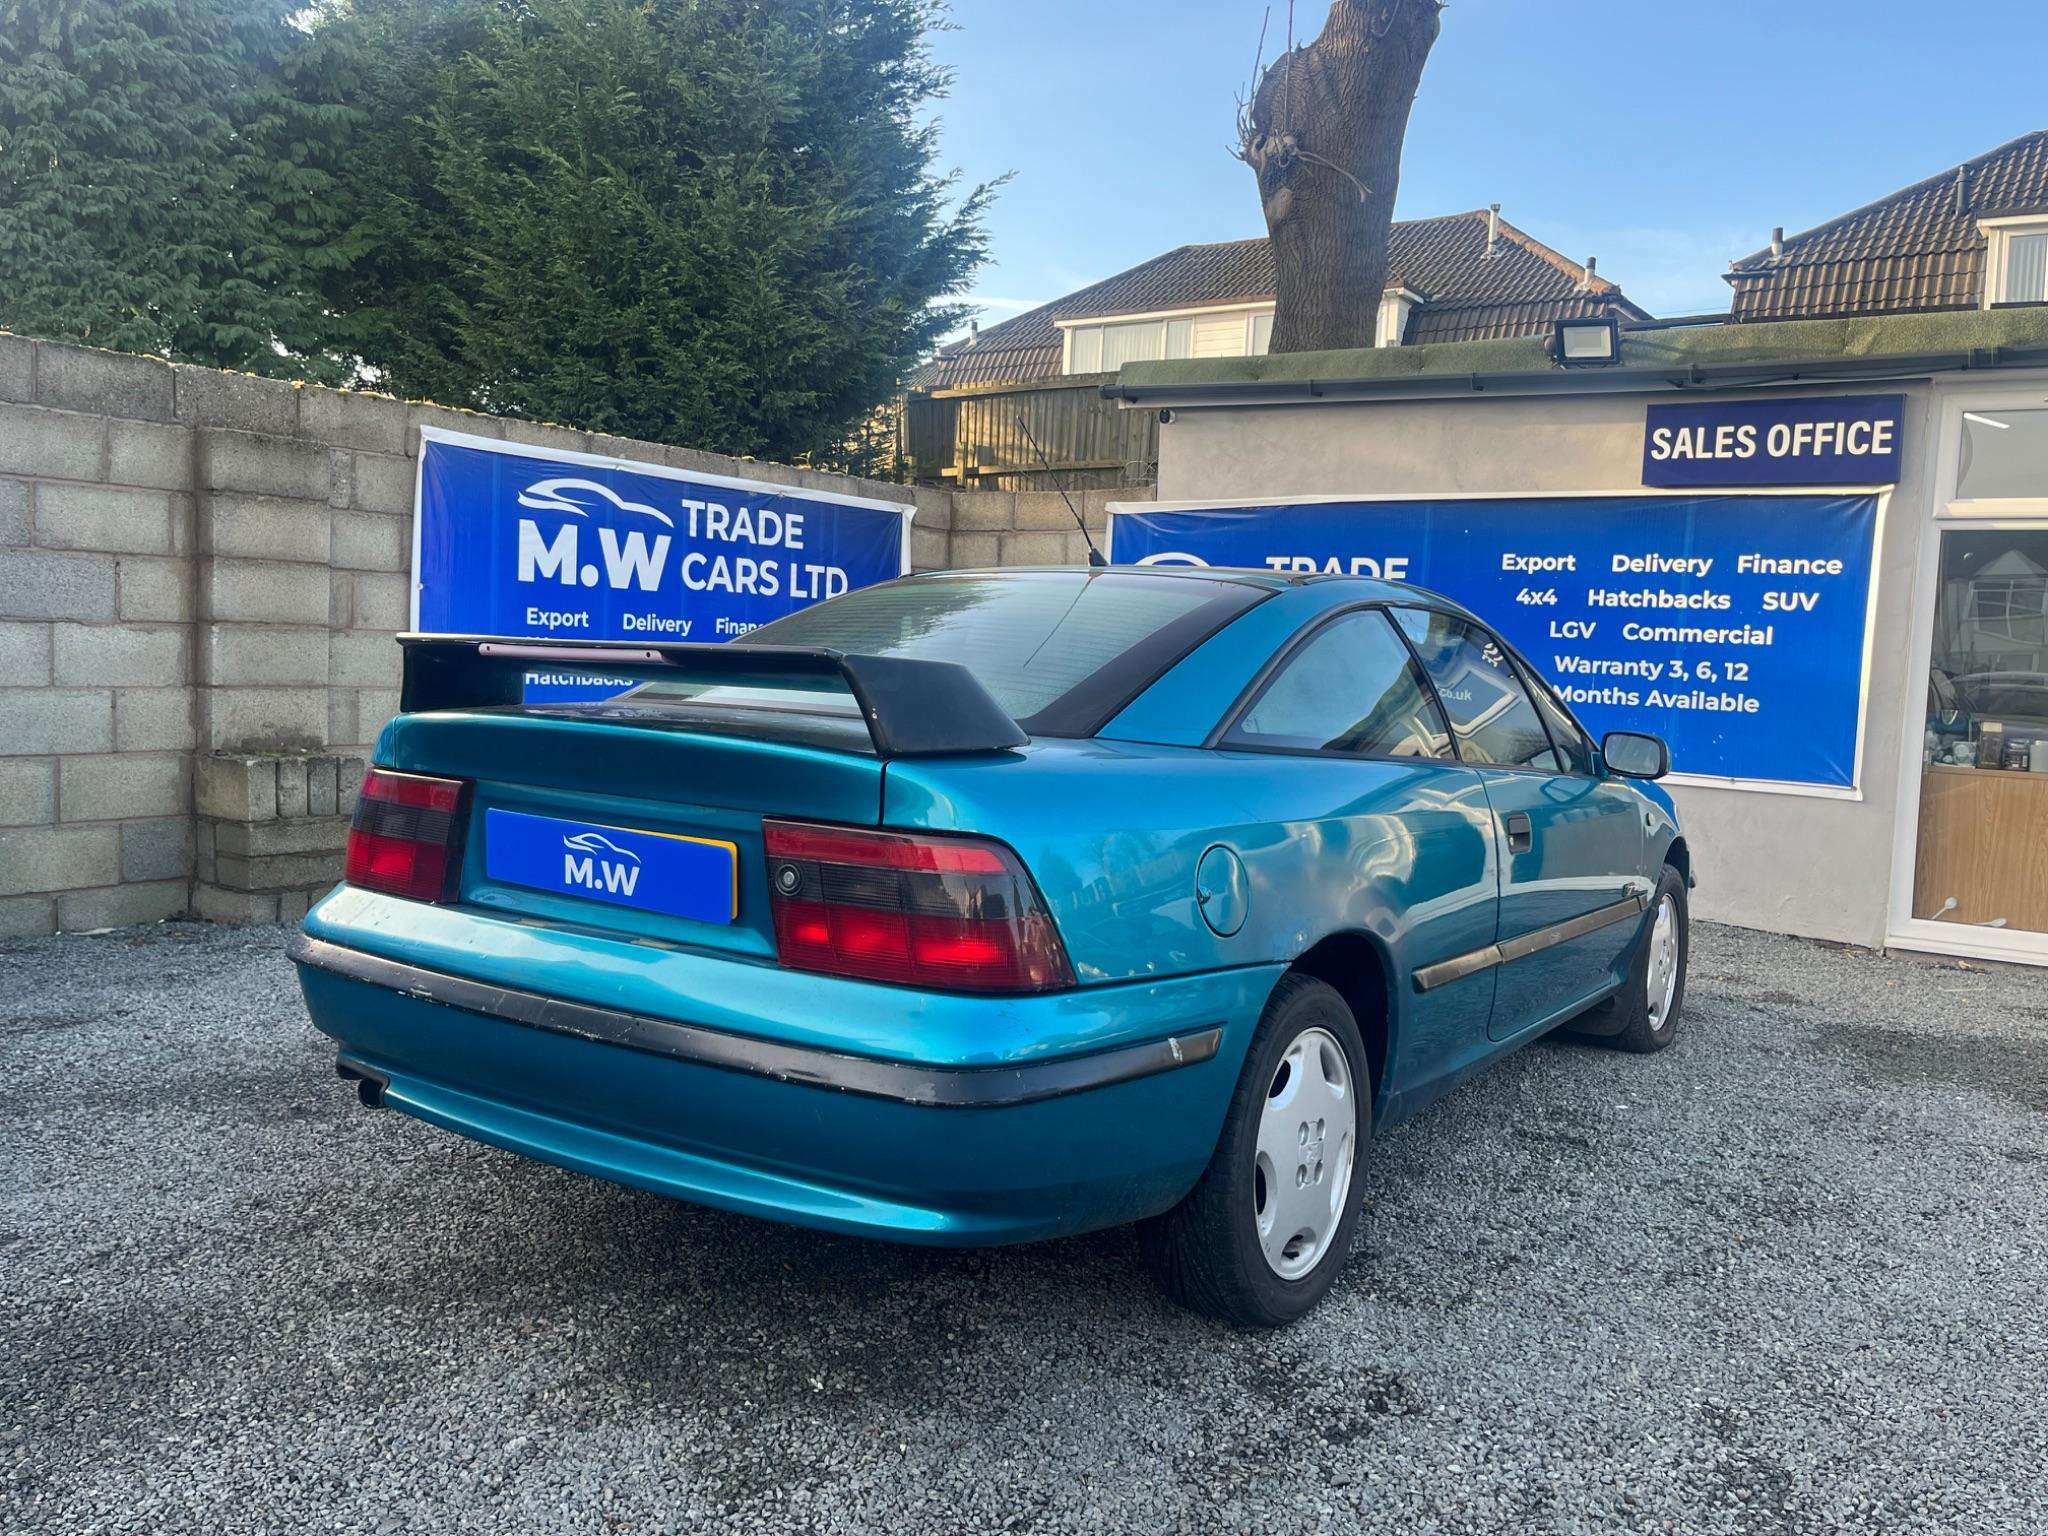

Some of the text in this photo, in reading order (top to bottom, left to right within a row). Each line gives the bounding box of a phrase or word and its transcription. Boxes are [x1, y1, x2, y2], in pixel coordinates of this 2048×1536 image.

[1651, 420, 1893, 460] SALES OFFICE
[682, 499, 804, 549] TRADE
[518, 519, 671, 591] M.W
[1503, 554, 1843, 577] Export Delivery Finance
[682, 553, 848, 599] CARS LTD
[1516, 589, 1819, 611] 4x4 Hatchbacks SUV
[527, 608, 588, 629] Export
[624, 614, 691, 636] Delivery
[1550, 621, 1773, 645] LGV Commercial
[1555, 656, 1748, 682] Warranty 3, 6, 12
[1553, 685, 1759, 712] Months Available
